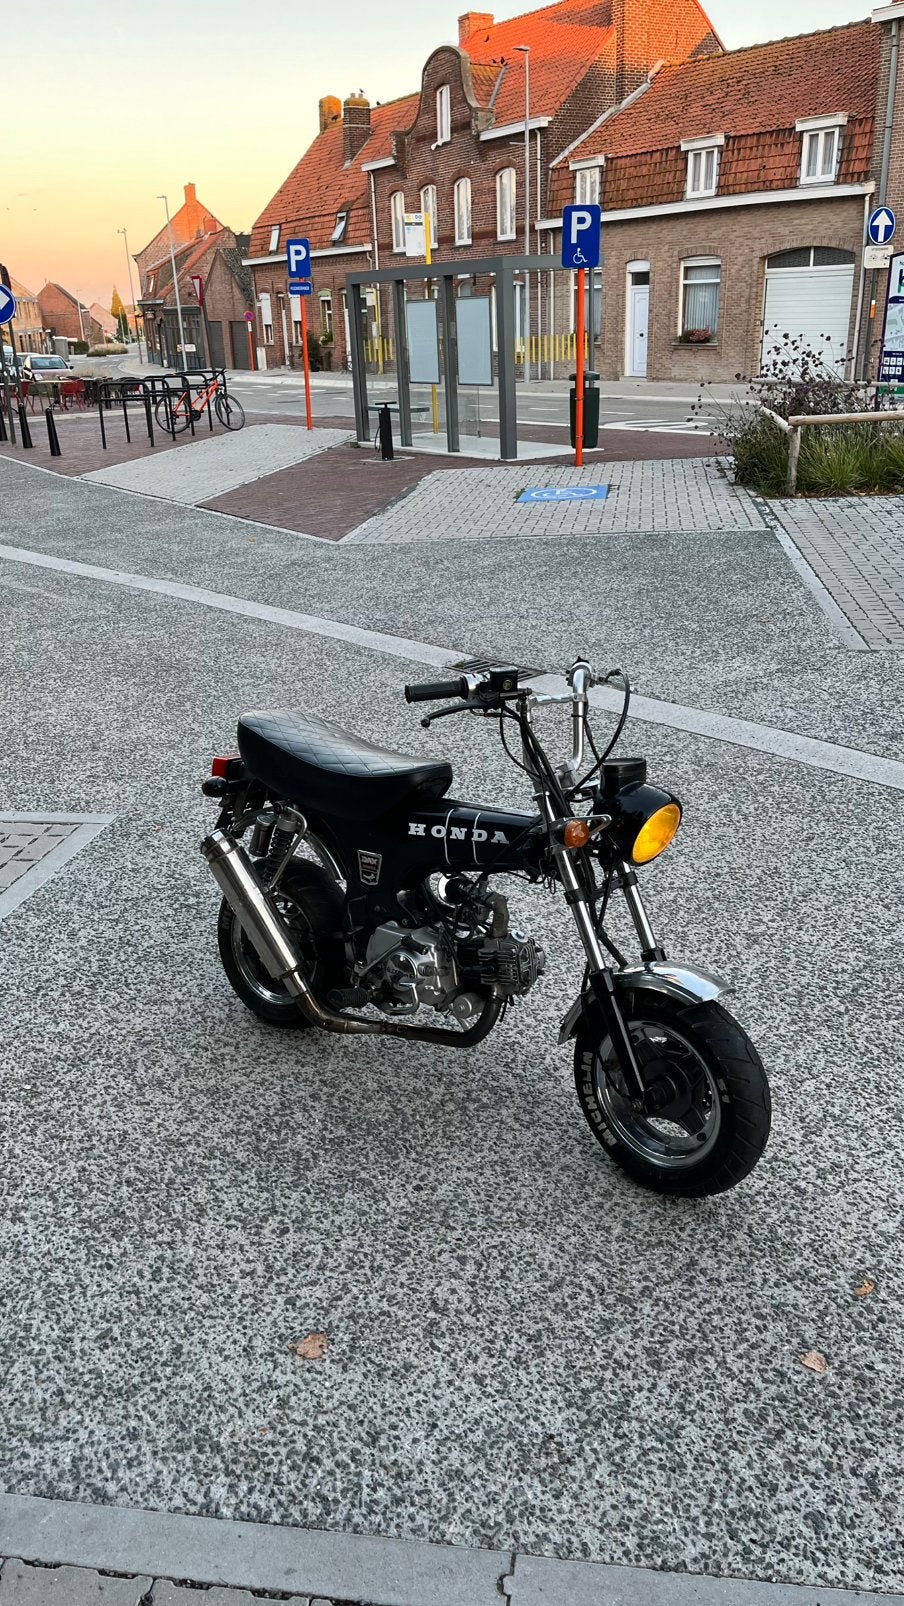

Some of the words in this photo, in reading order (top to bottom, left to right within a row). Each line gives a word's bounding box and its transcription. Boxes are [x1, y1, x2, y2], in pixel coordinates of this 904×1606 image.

[571, 211, 592, 244] P
[290, 245, 307, 272] P
[408, 822, 510, 845] HONDA
[581, 1051, 618, 1147] MICHELIN
